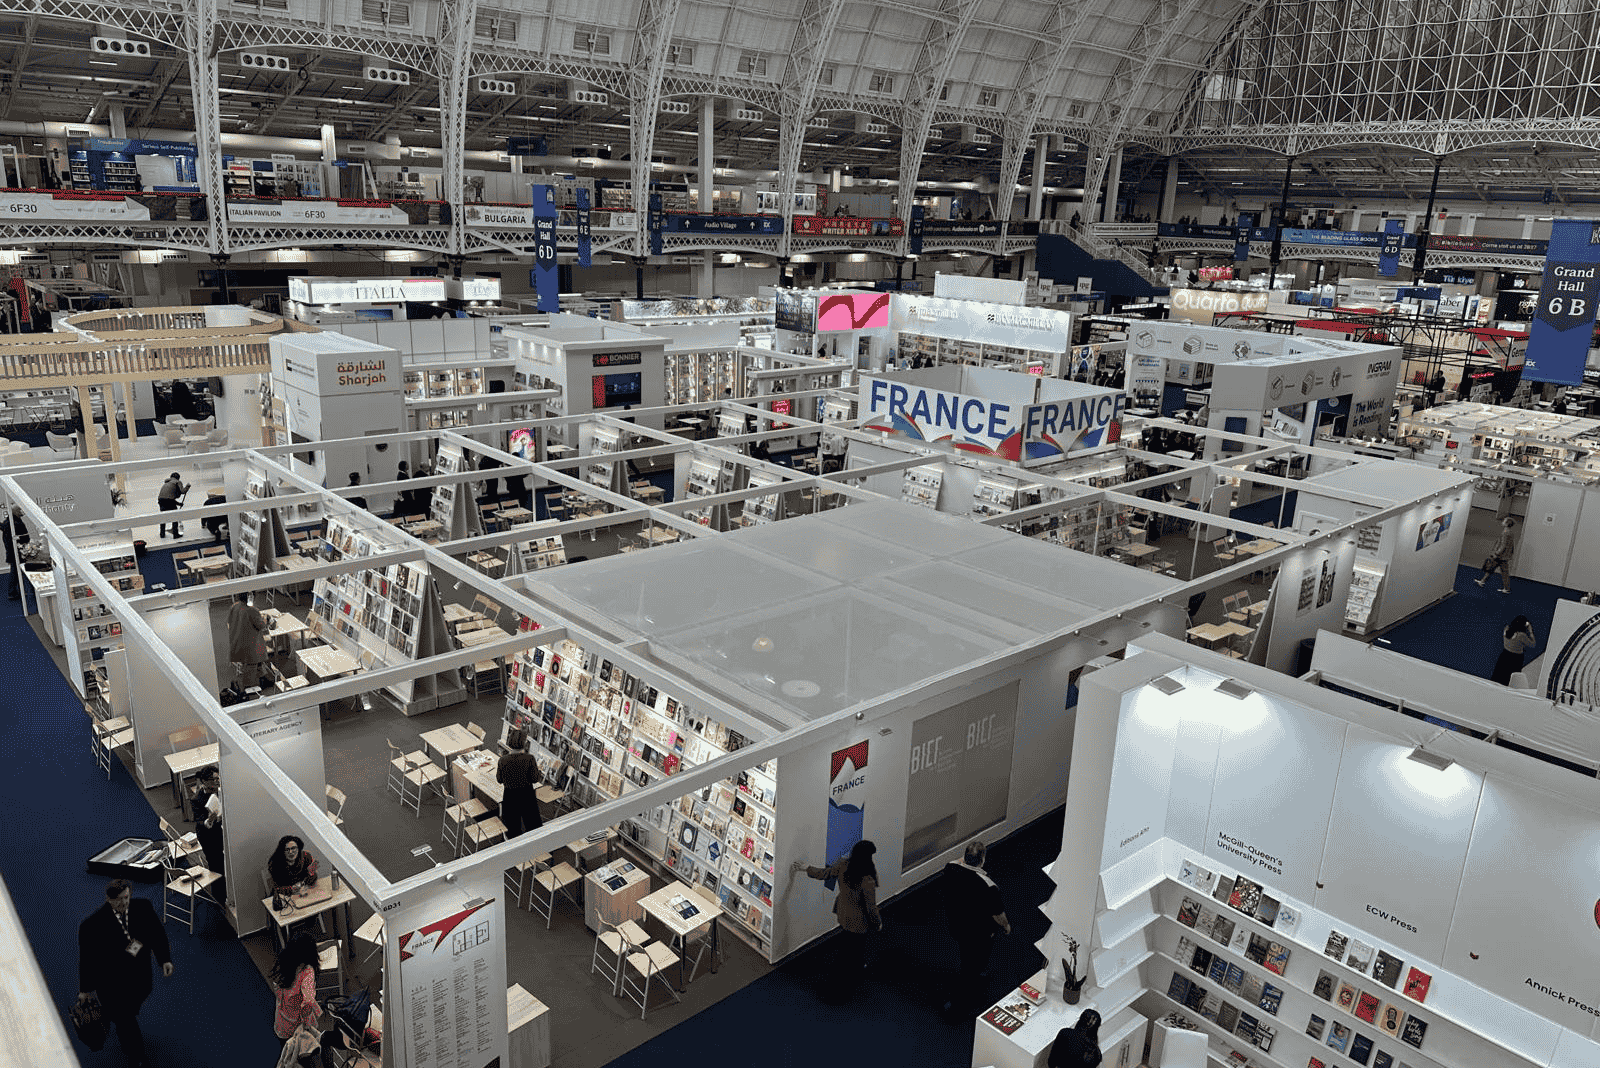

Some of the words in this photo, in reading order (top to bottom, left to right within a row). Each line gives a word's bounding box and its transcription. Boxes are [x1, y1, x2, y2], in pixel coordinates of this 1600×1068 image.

[10, 203, 38, 213] 6F30
[304, 210, 326, 219] 6F30
[484, 215, 527, 224] BULGARIA
[537, 220, 553, 229] Grand
[720, 222, 737, 230] Village
[540, 231, 551, 241] Hall
[538, 245, 545, 258] 6
[546, 246, 554, 259] D
[1554, 266, 1595, 279] Grand
[355, 286, 407, 300] ITALIA
[1557, 280, 1585, 292] Hall
[1173, 289, 1239, 311] Quarto
[1548, 298, 1563, 315] 6
[1568, 299, 1586, 317] B
[609, 352, 640, 362] BONNIER
[337, 359, 386, 373] الشارقة
[1367, 360, 1392, 374] INGRAM
[338, 374, 387, 387] Sharjah
[871, 380, 1011, 439] FRANCE
[1355, 402, 1367, 414] The
[1366, 397, 1385, 411] World
[1026, 393, 1127, 439] FRANCE
[1352, 416, 1358, 427] is
[250, 727, 279, 739] LITERARY
[279, 719, 303, 731] AGENCY
[832, 775, 865, 796] FRANCE
[1218, 831, 1283, 867] McGill-Queen's
[1217, 840, 1259, 865] University
[1258, 857, 1282, 876] Press
[383, 901, 401, 913] 6D31
[1366, 904, 1390, 921] ECW
[1390, 914, 1418, 934] Press
[411, 937, 435, 951] FRANCE
[1524, 977, 1566, 1002] Annick
[1567, 994, 1600, 1017] Press
